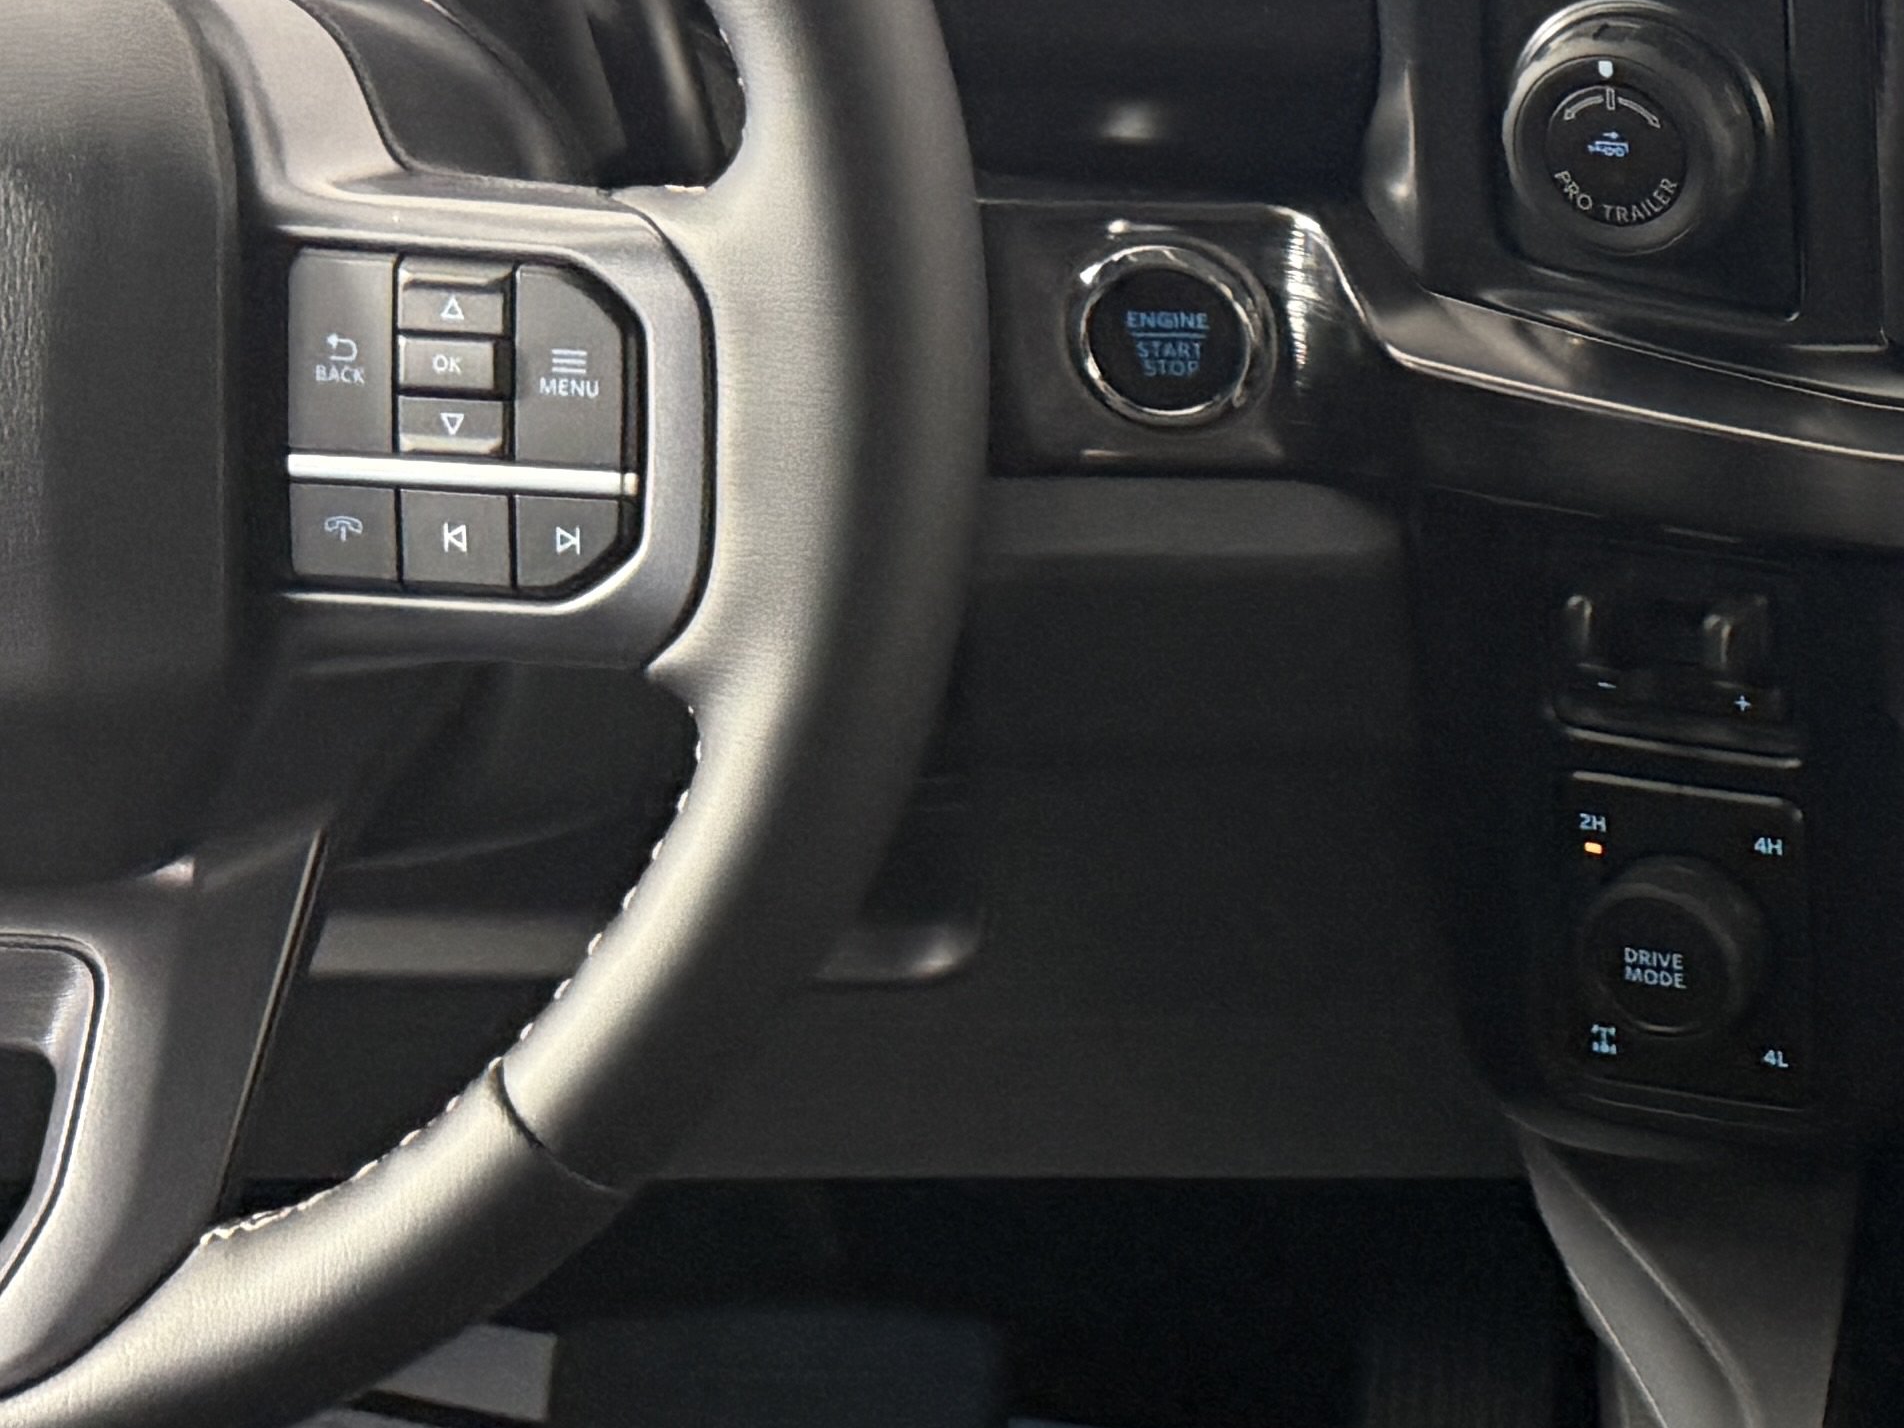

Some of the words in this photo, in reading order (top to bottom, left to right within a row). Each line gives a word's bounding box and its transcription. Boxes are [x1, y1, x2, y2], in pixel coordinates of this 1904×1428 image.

[1554, 170, 1593, 211] PRO
[1602, 177, 1678, 223] TRAILER
[1126, 310, 1210, 331] ENGINE
[1136, 341, 1203, 359] START
[315, 365, 366, 385] BACK
[432, 355, 463, 375] OK
[1143, 359, 1200, 377] STOP
[539, 377, 600, 399] MENU
[1579, 813, 1607, 833] 2H
[1753, 836, 1784, 857] 4H
[1623, 947, 1684, 971] DRIVE
[1624, 966, 1687, 990] MODE
[1762, 1049, 1789, 1069] 4L
